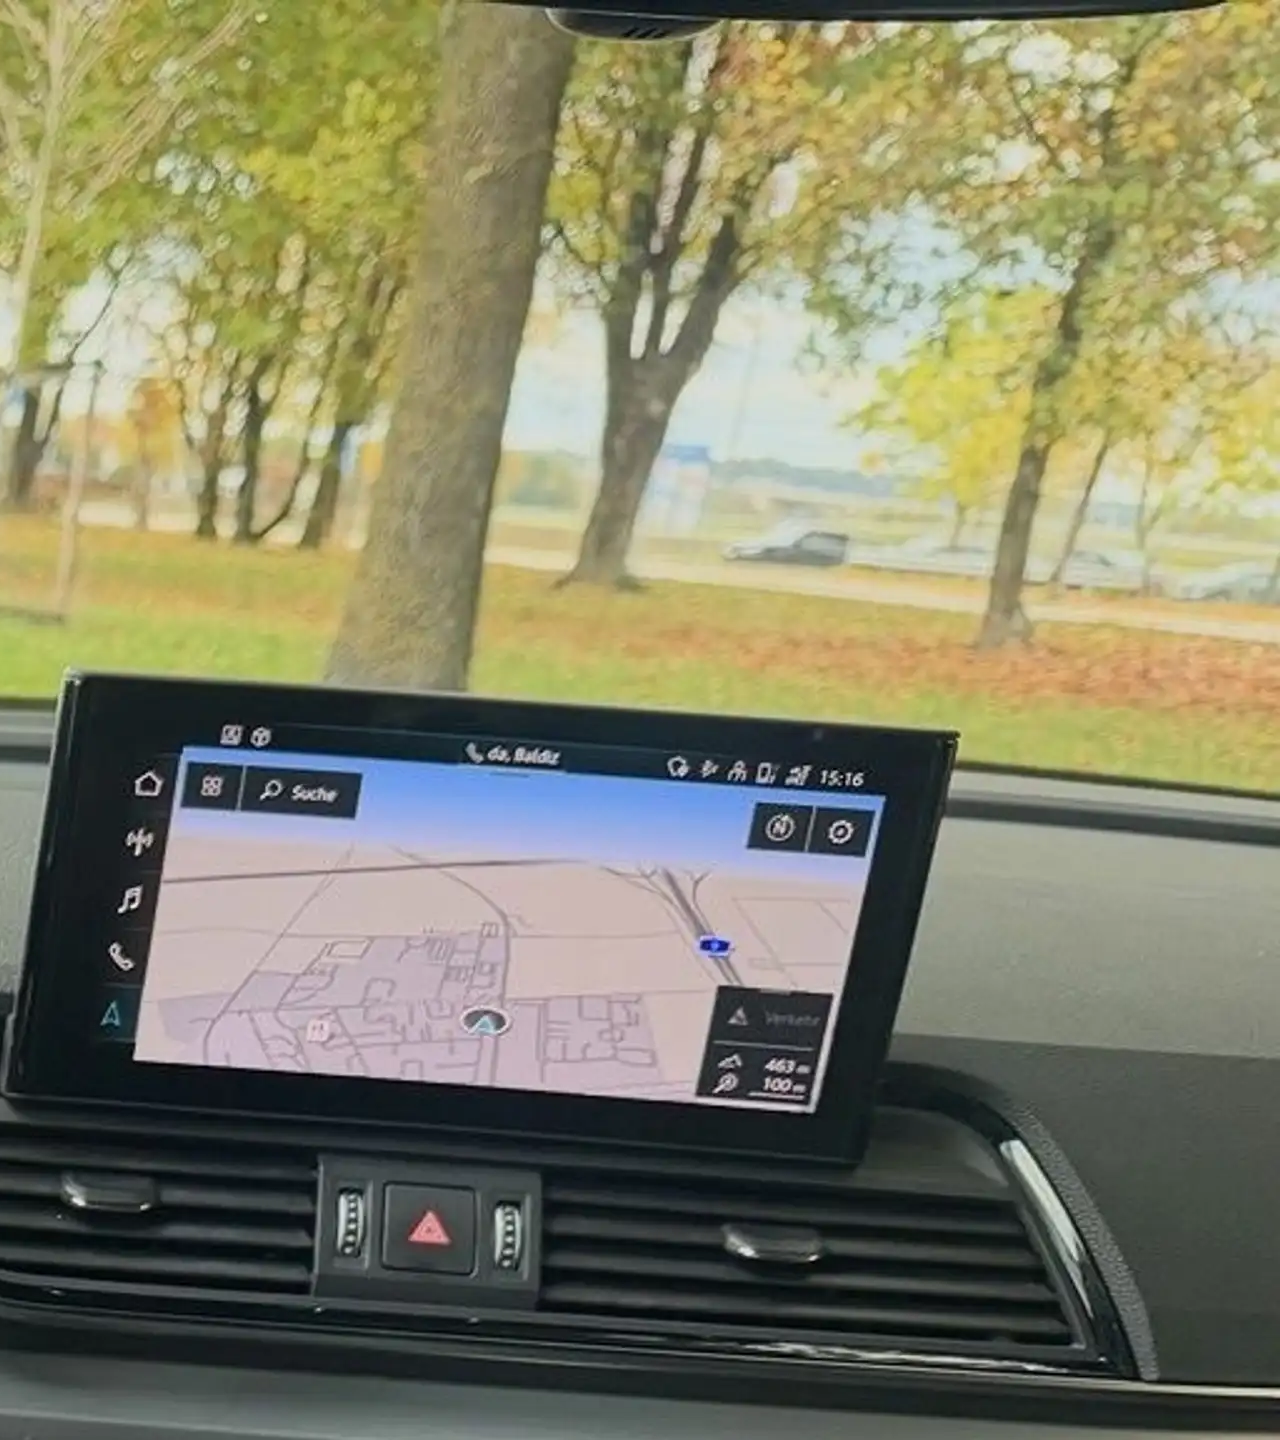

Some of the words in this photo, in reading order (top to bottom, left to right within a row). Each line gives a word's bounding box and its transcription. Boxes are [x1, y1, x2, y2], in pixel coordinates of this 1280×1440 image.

[819, 769, 865, 788] 15:16
[291, 784, 339, 803] Suche
[765, 1058, 796, 1074] 463
[763, 1075, 792, 1092] 100
